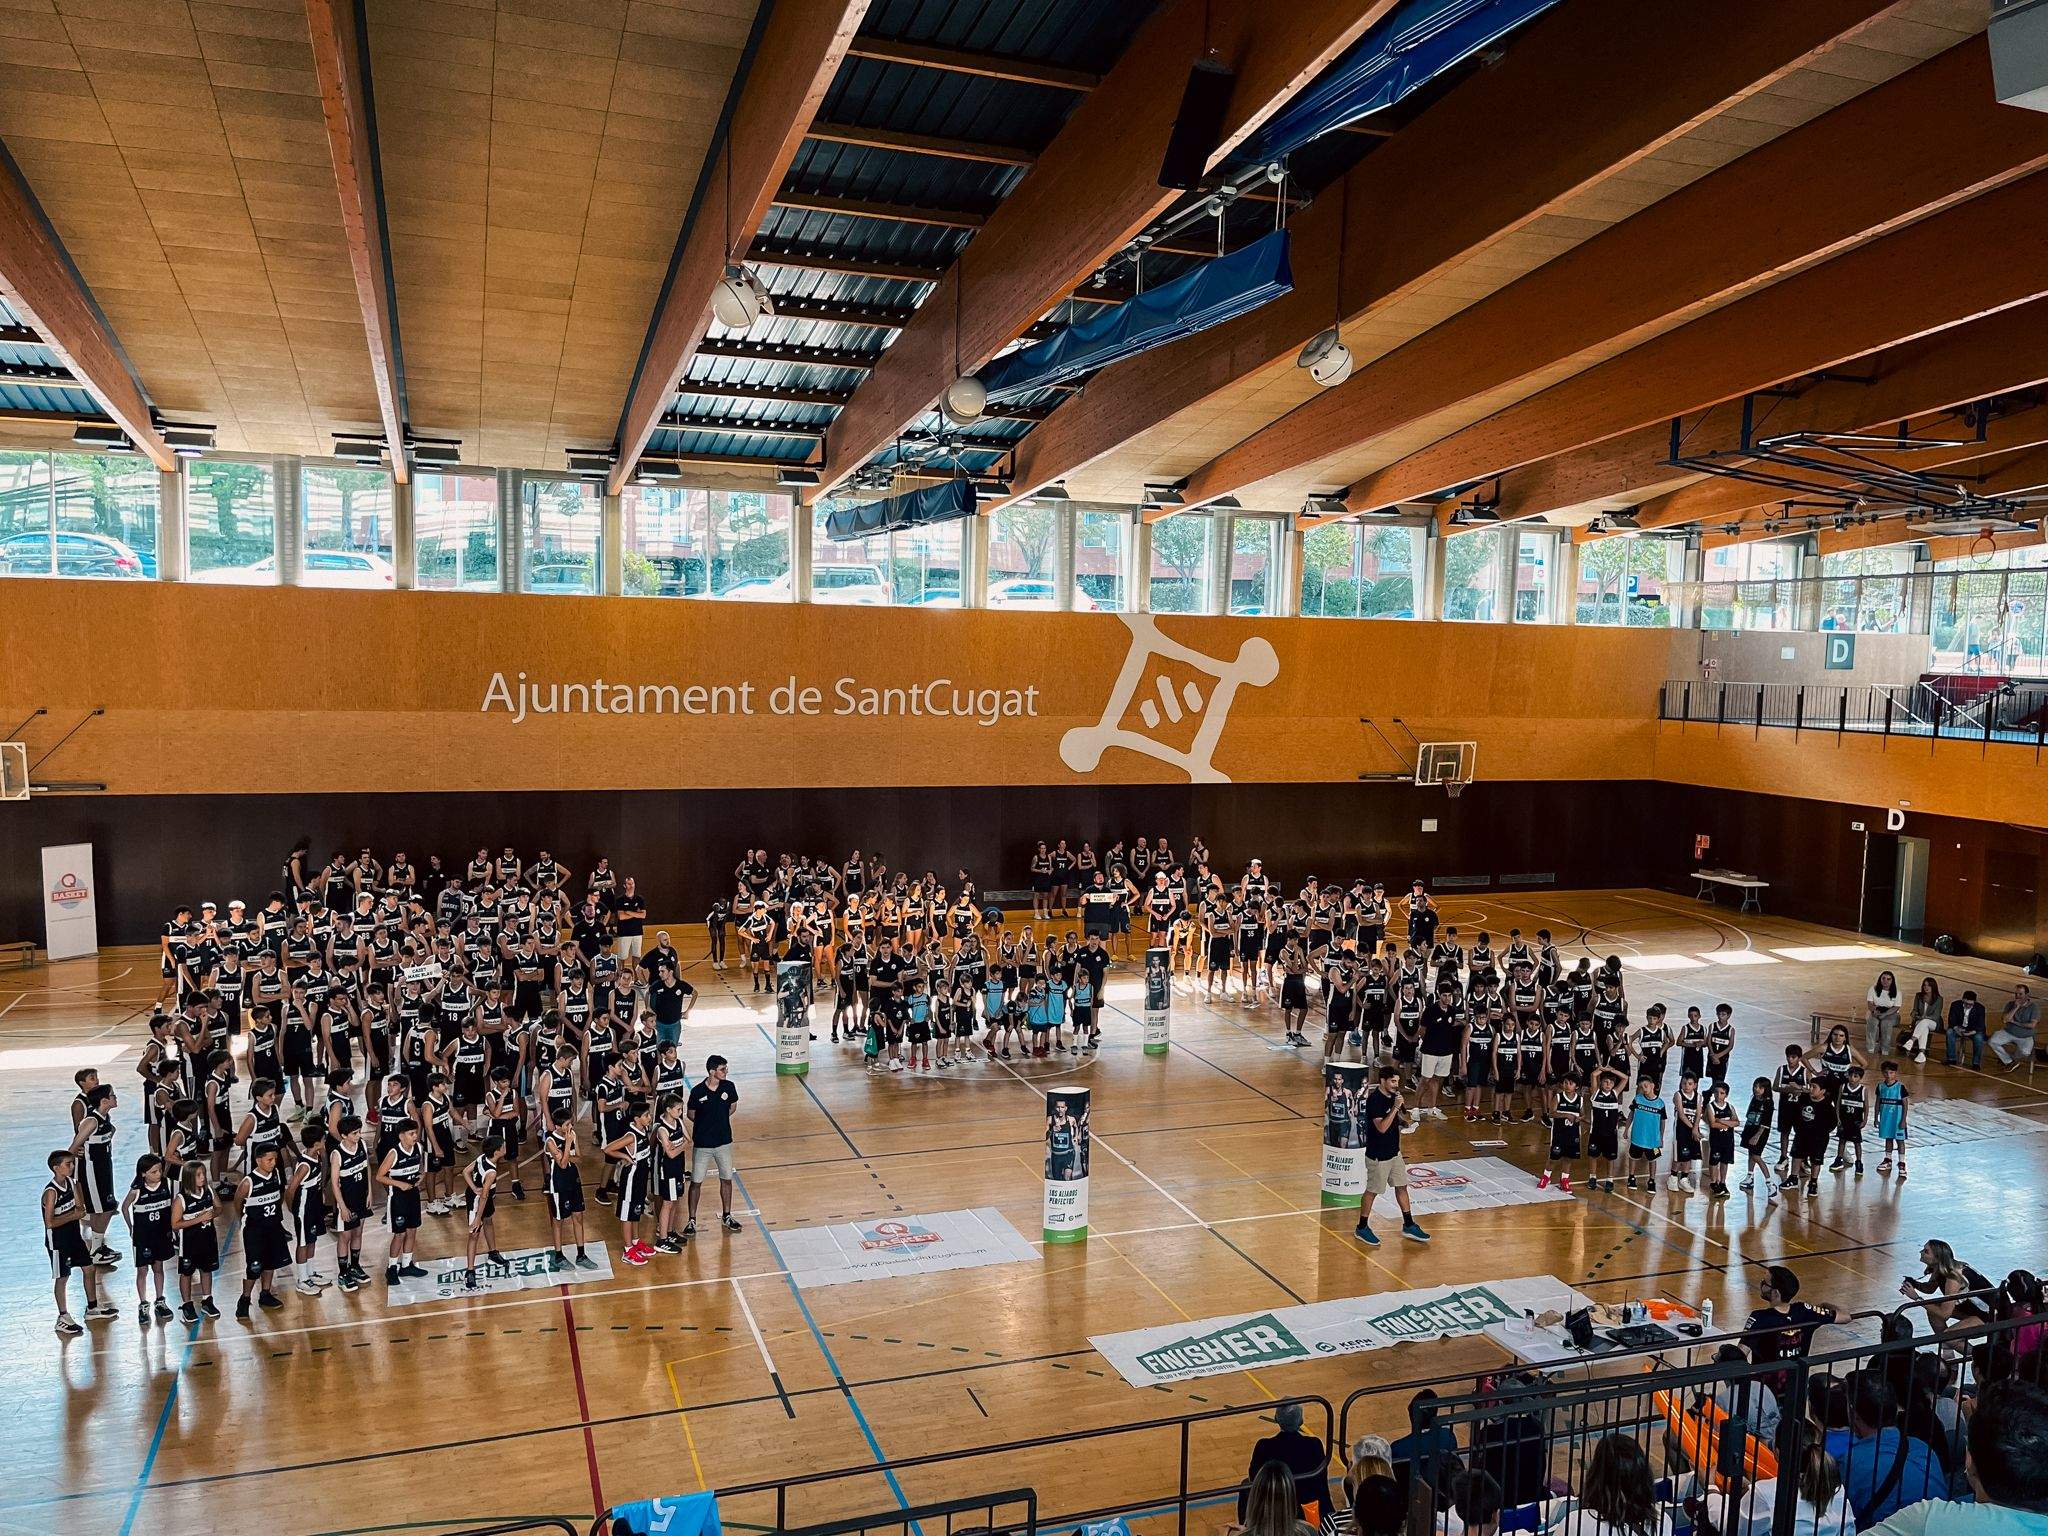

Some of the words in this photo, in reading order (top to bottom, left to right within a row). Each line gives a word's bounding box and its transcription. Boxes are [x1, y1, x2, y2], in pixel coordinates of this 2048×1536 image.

[1832, 639, 1849, 663] D
[480, 672, 754, 724] Ajuntament
[768, 675, 822, 716] de
[833, 677, 1039, 727] SantCugat
[1887, 809, 1905, 831] D
[62, 874, 76, 887] Q
[54, 890, 86, 900] BASKET
[225, 992, 235, 1001] 10
[448, 1012, 458, 1022] 18
[573, 1014, 582, 1023] 00
[620, 1011, 628, 1020] 14
[1603, 1020, 1612, 1028] 13
[215, 1038, 220, 1048] 5
[542, 1046, 548, 1060] 2
[470, 1065, 476, 1074] 4
[384, 1124, 392, 1132] 21
[354, 1172, 362, 1182] 19
[1407, 1168, 1437, 1177] Q
[258, 1192, 280, 1202] Qbasket
[264, 1204, 276, 1217] 32
[149, 1212, 160, 1221] 68
[875, 1222, 910, 1236] Q
[441, 1256, 547, 1284] FINSHER
[1143, 1324, 1290, 1372] FINISHER
